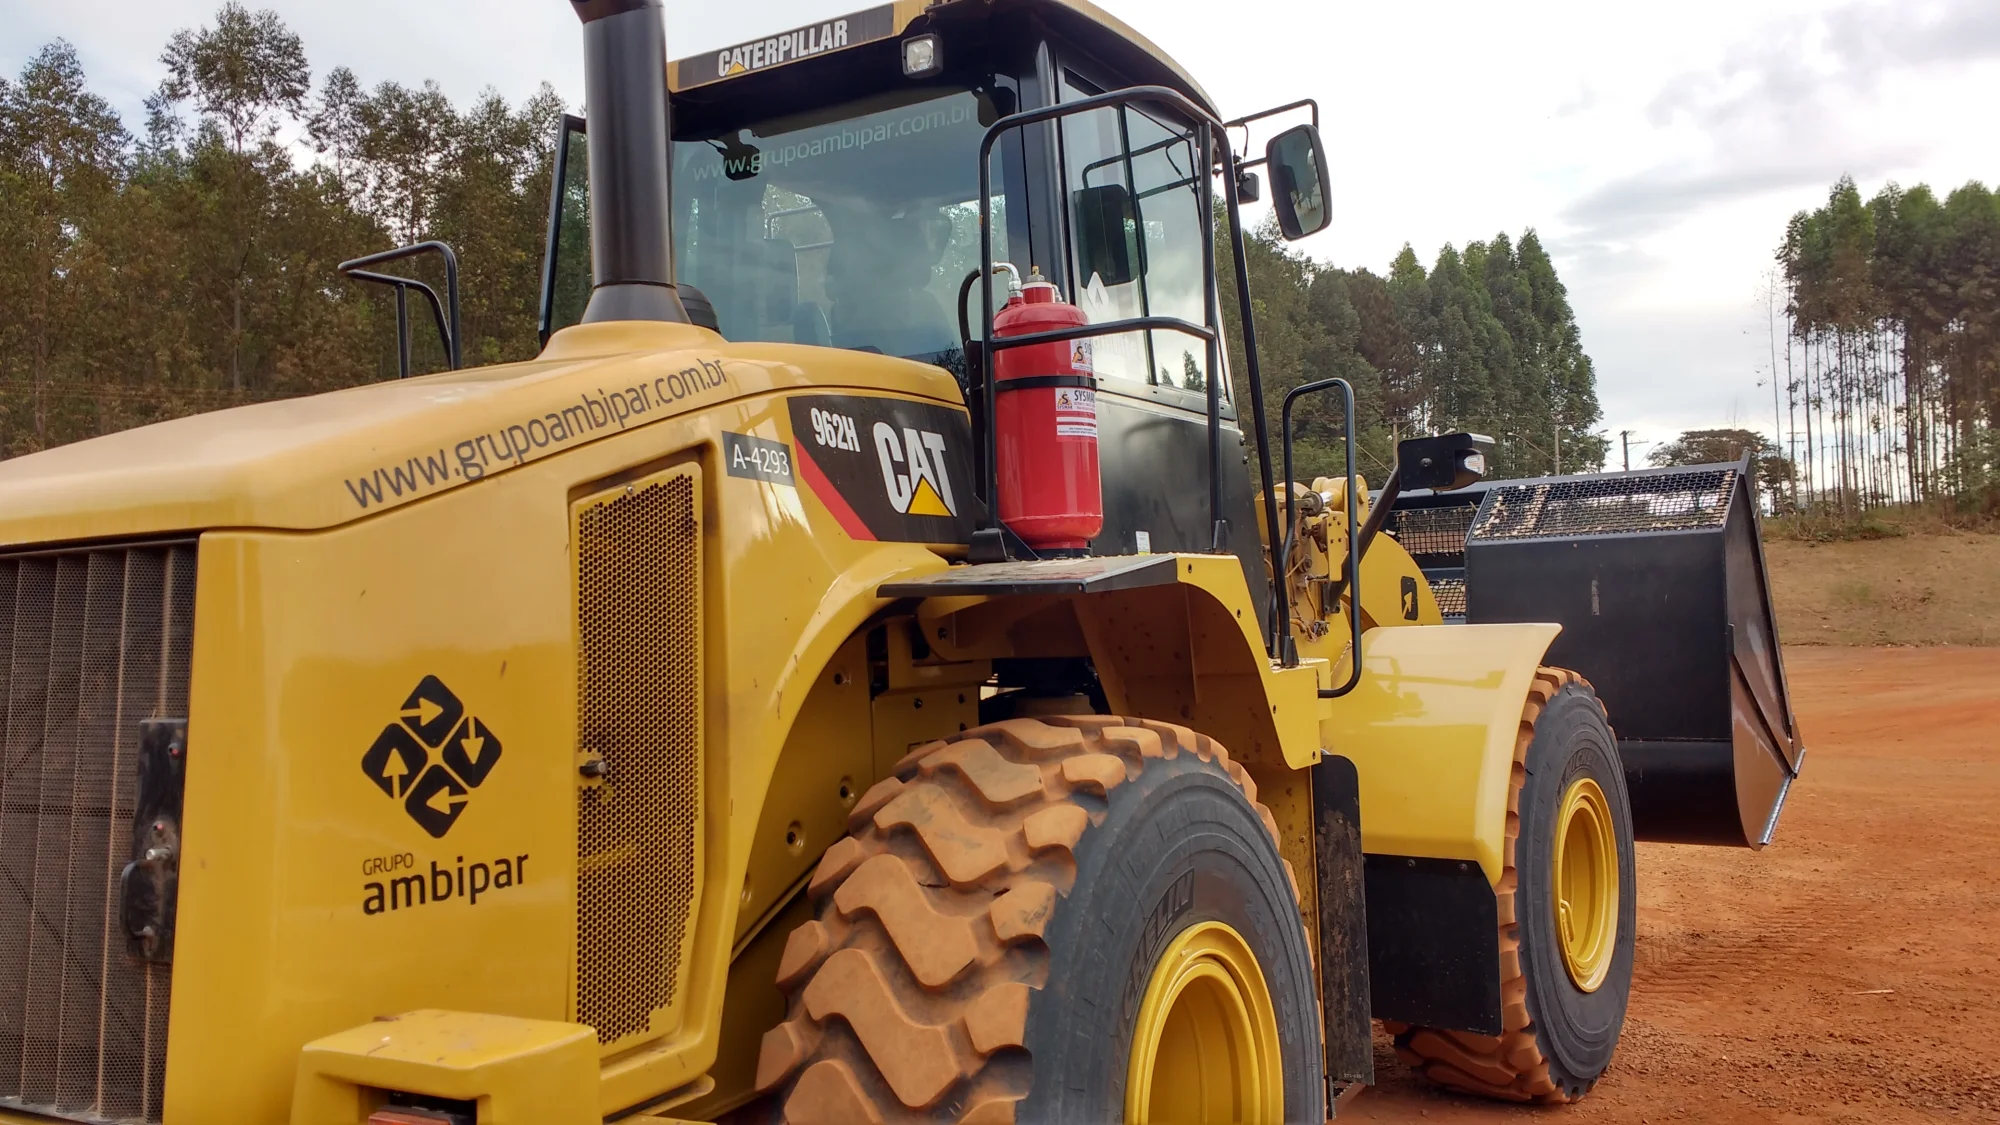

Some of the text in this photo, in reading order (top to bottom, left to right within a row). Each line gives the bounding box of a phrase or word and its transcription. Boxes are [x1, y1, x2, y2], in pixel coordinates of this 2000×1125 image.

[718, 19, 848, 77] CATERPILLAR
[692, 102, 975, 182] www.grupoambipar.com.br
[344, 357, 728, 509] www.grupoambipar.com.br
[810, 407, 861, 452] 962H
[733, 443, 790, 477] A-4293
[873, 421, 957, 517] CAT
[362, 852, 414, 876] GRUPO
[363, 853, 529, 916] ambipar
